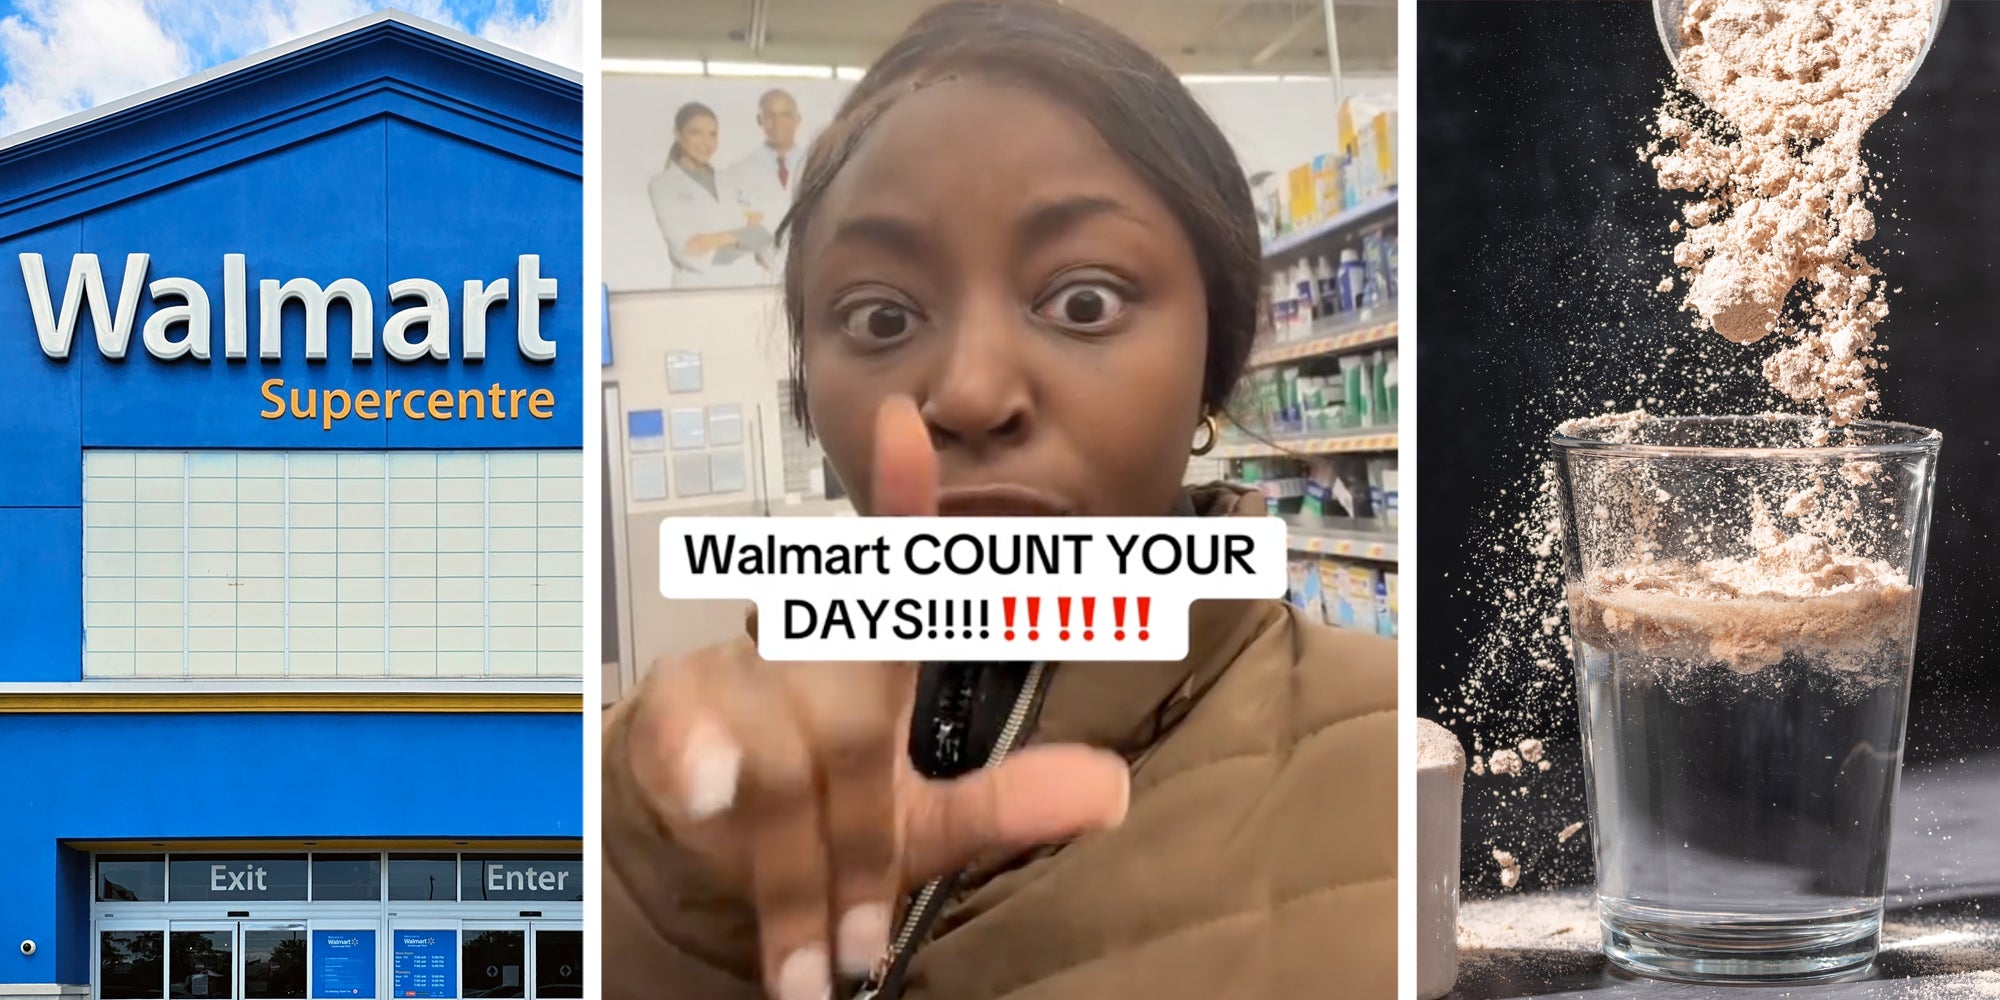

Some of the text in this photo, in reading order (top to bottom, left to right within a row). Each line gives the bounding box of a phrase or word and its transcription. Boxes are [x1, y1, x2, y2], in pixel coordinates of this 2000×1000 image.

[18, 253, 558, 361] Walmart
[260, 379, 555, 430] Supercentre
[210, 864, 267, 891] Exit
[488, 864, 569, 891] Enter
